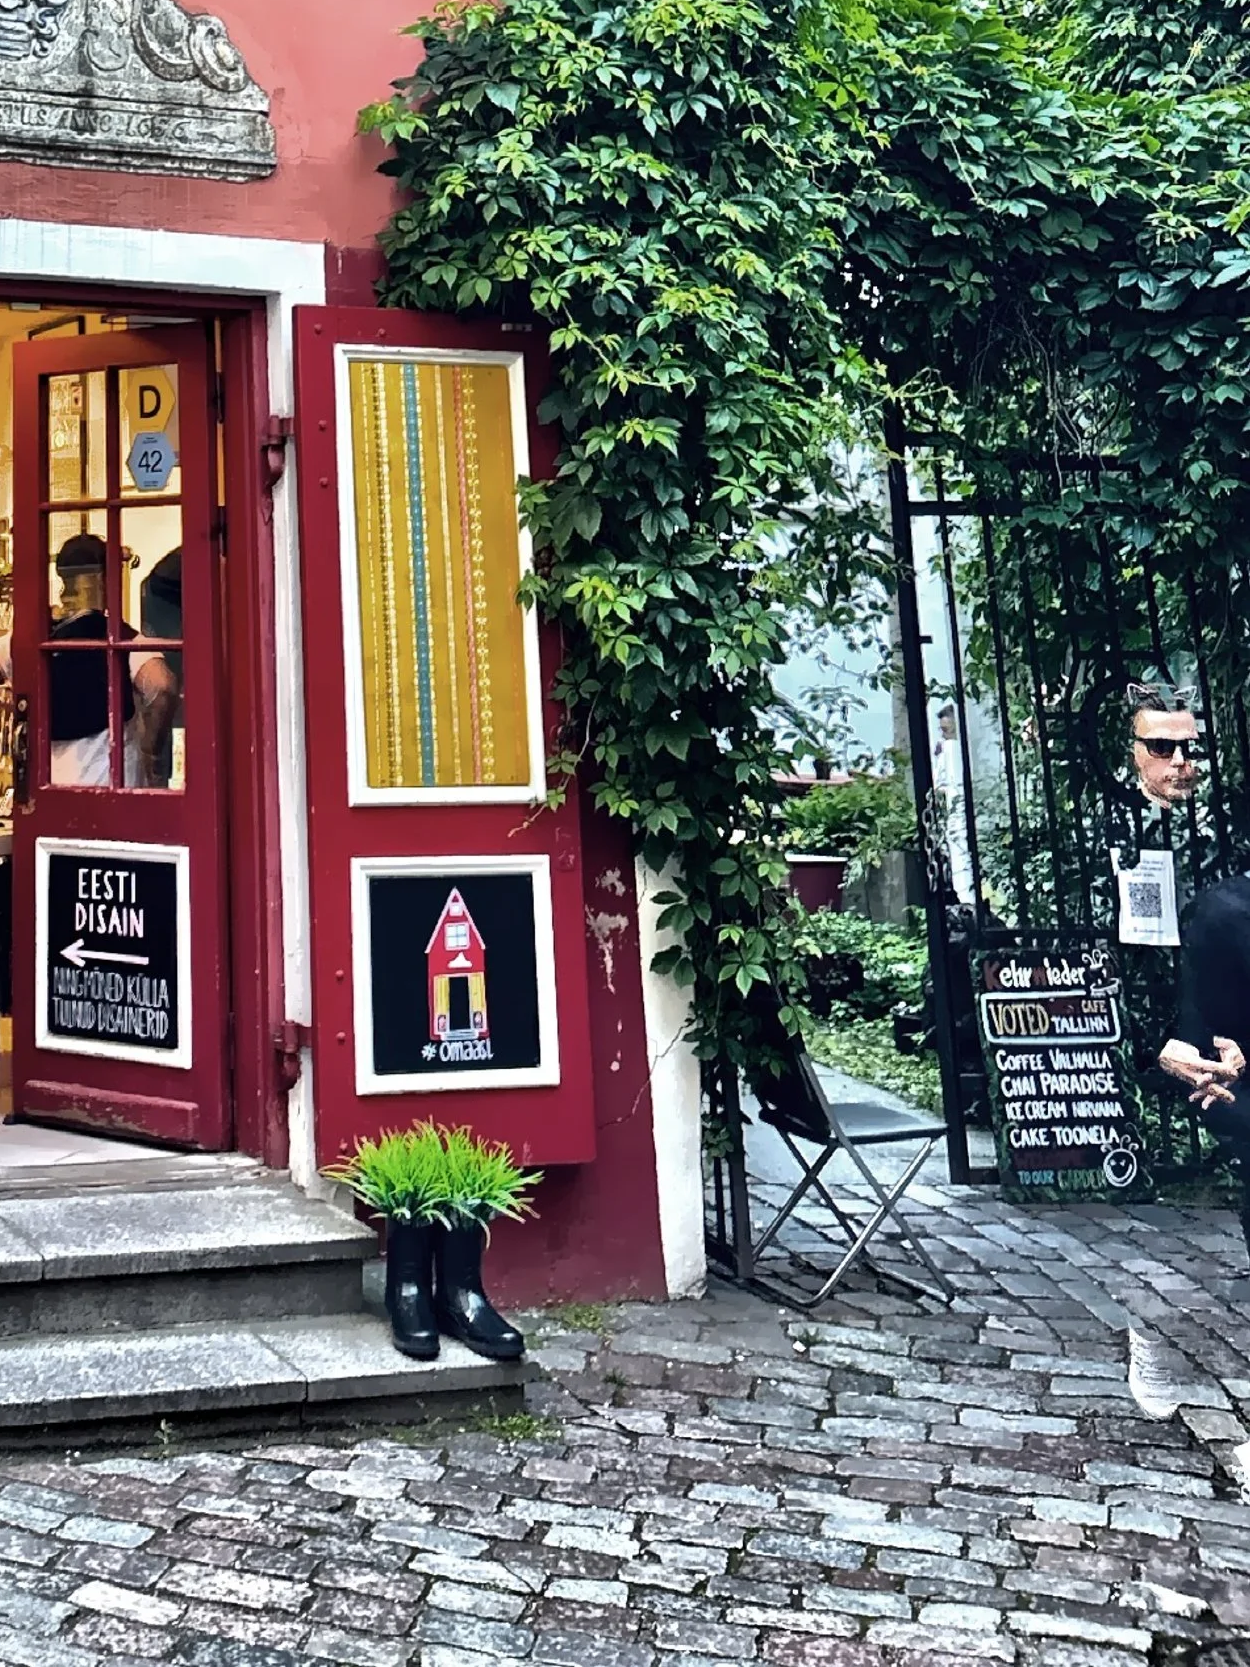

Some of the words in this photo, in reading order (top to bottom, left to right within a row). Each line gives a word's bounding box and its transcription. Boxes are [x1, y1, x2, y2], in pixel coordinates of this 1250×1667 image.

[139, 384, 161, 419] D
[137, 450, 163, 473] 42
[78, 868, 136, 904] EESTI
[75, 902, 144, 939] DISAIN
[1081, 999, 1107, 1013] CAFE
[988, 1001, 1050, 1036] VOTED
[1050, 1014, 1110, 1034] TALLINN
[995, 1049, 1046, 1071] COFFEE
[1048, 1047, 1112, 1071] VALHALLA
[1000, 1074, 1037, 1098] CHAI
[1039, 1072, 1120, 1096] PARADISE
[1005, 1101, 1025, 1121] ICE
[1024, 1100, 1069, 1121] CREAM
[1071, 1100, 1125, 1118] NIRVANA
[1010, 1127, 1050, 1148] CAKE
[1051, 1124, 1120, 1146] TOONELA
[1017, 1170, 1030, 1185] TO
